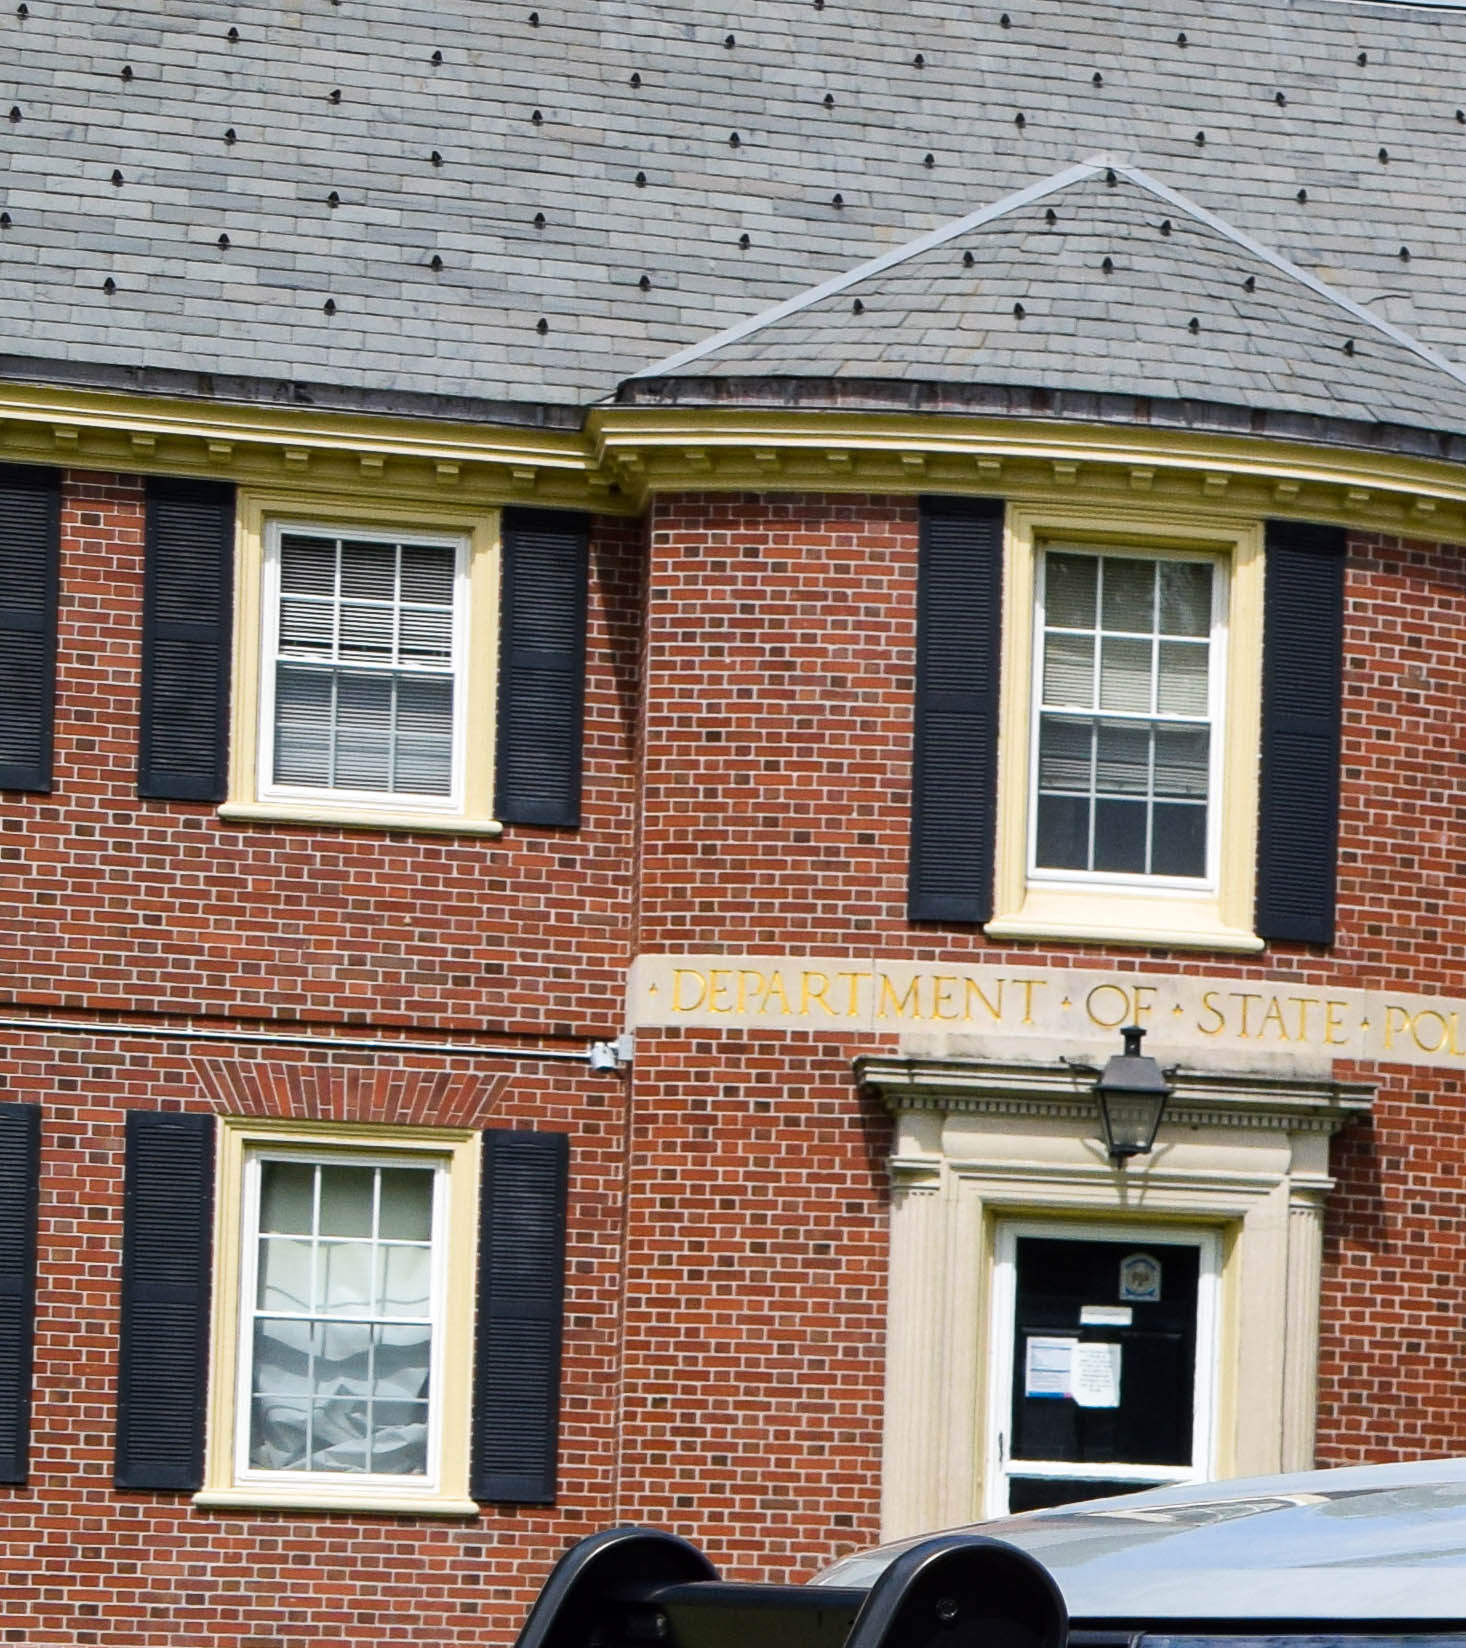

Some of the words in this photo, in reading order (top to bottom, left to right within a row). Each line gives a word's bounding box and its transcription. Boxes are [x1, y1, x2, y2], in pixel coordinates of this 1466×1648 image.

[671, 968, 1048, 1025] DEPARTMENT
[1086, 983, 1157, 1028] OF
[1197, 991, 1350, 1045] STATE
